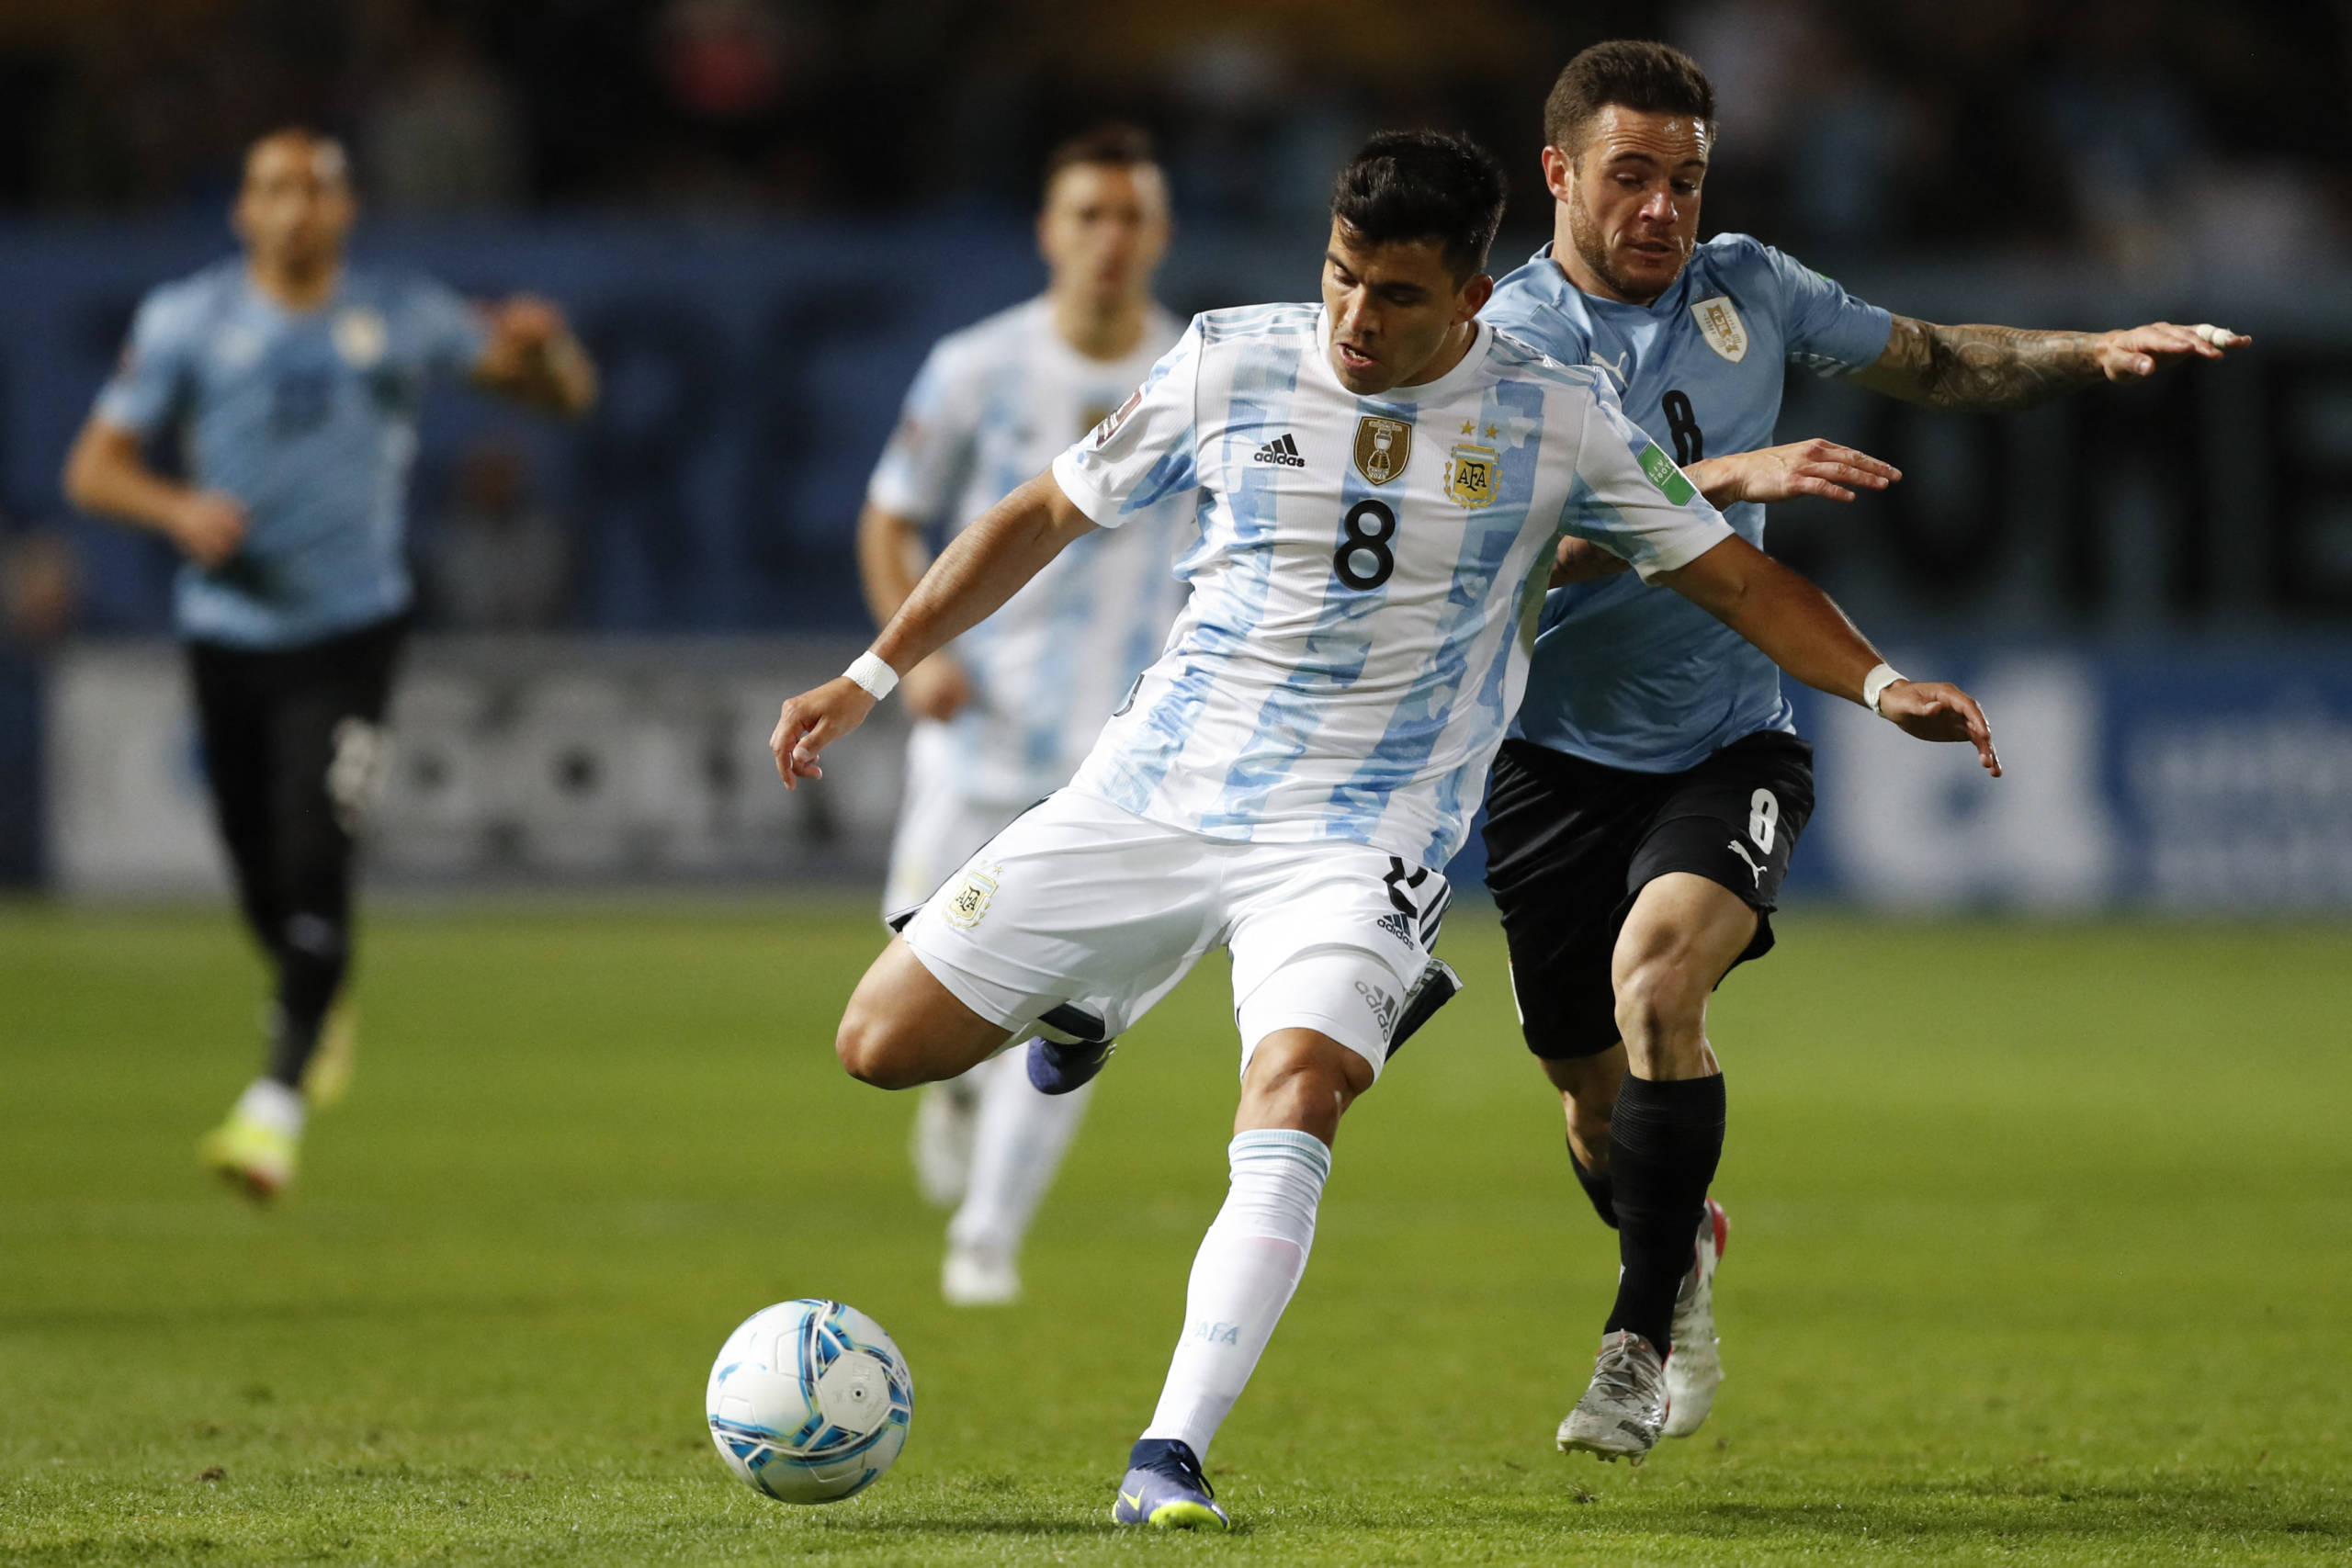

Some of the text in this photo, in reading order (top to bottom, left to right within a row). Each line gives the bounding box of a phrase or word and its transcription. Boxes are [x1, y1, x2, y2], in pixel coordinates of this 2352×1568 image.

[1662, 389, 1703, 468] 8
[1456, 461, 1487, 492] AFA
[1333, 500, 1396, 592] 8
[1748, 787, 1780, 855] 8
[956, 885, 980, 912] AFA
[1376, 919, 1415, 952] adidas
[1354, 980, 1389, 1043] adida
